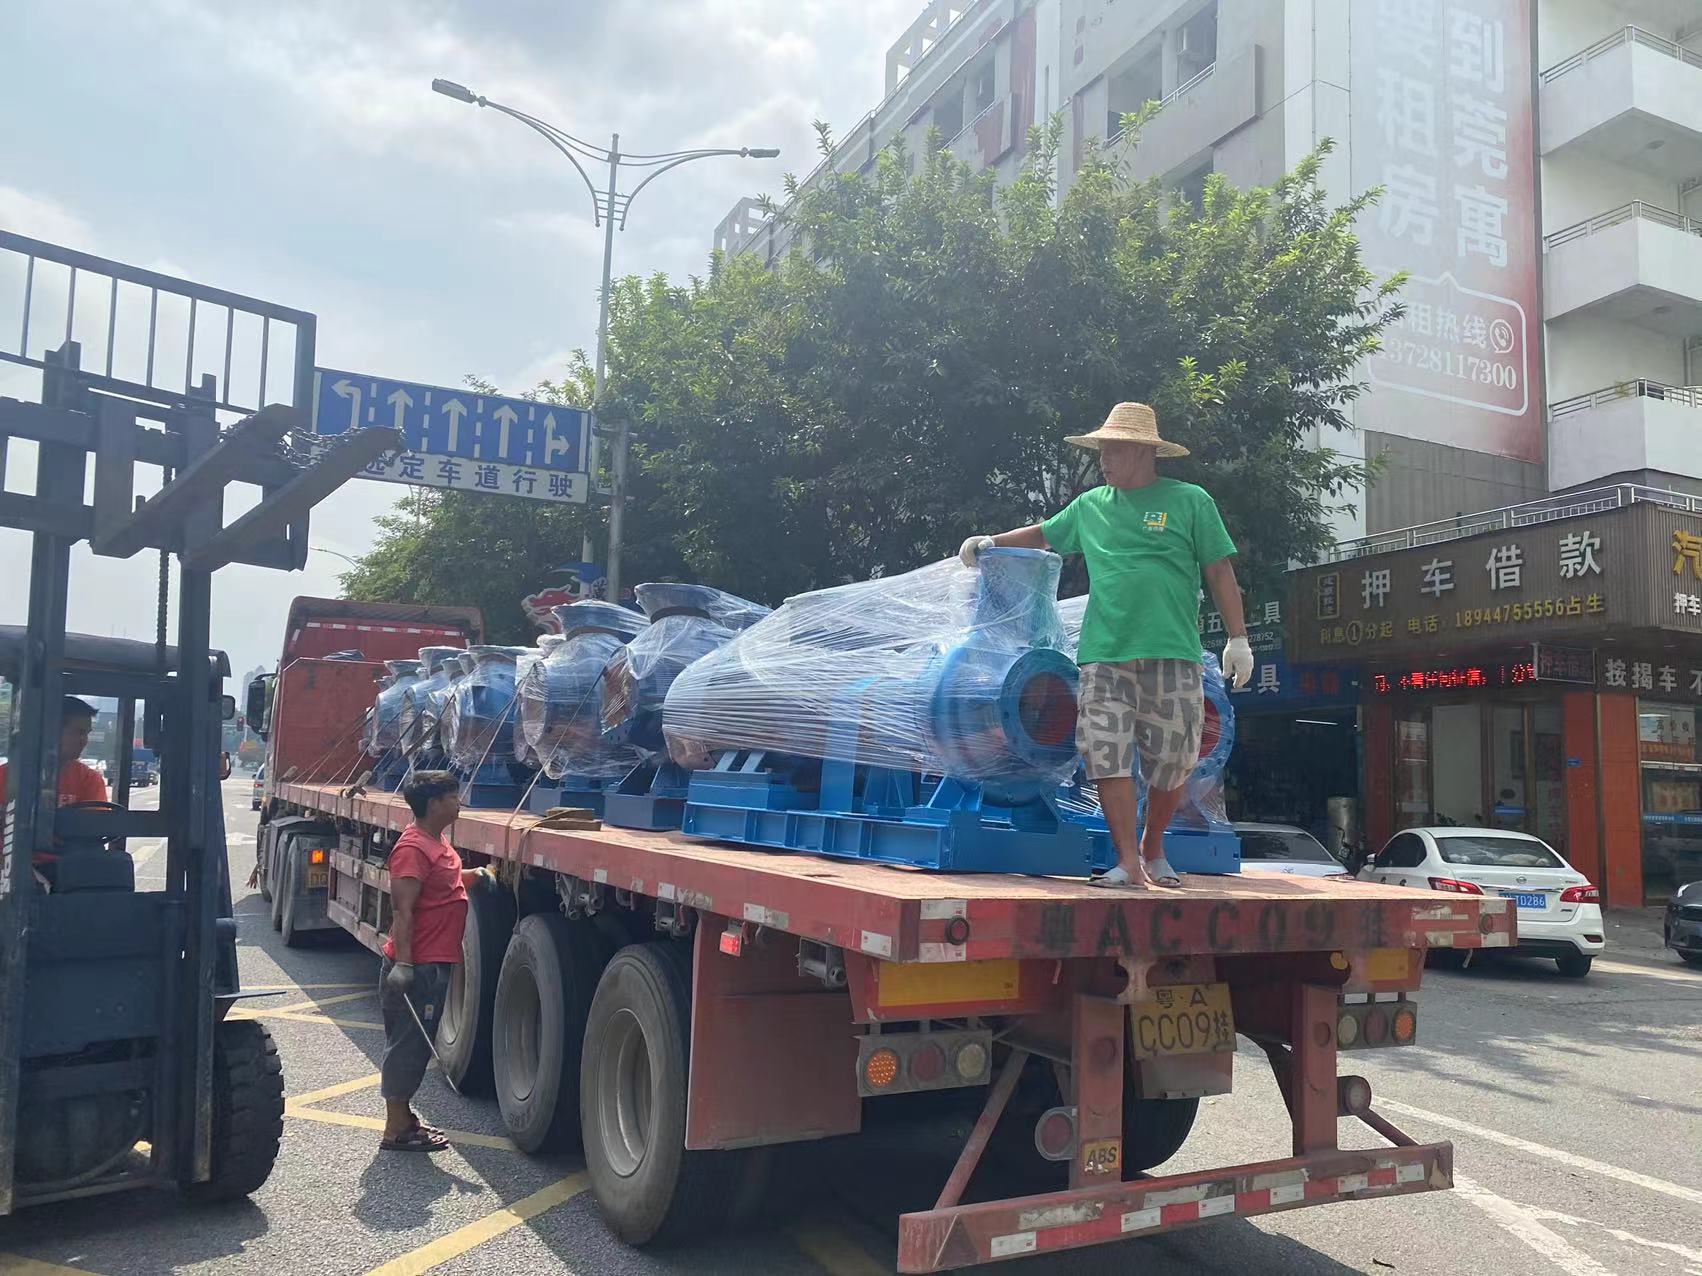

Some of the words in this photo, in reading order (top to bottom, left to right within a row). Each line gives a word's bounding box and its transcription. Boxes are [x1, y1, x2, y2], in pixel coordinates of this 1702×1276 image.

[1398, 302, 1487, 350] 租热线
[1361, 531, 1602, 609] 押车借款
[1139, 1010, 1229, 1055] CC09挂
[1087, 1147, 1117, 1168] ABS
